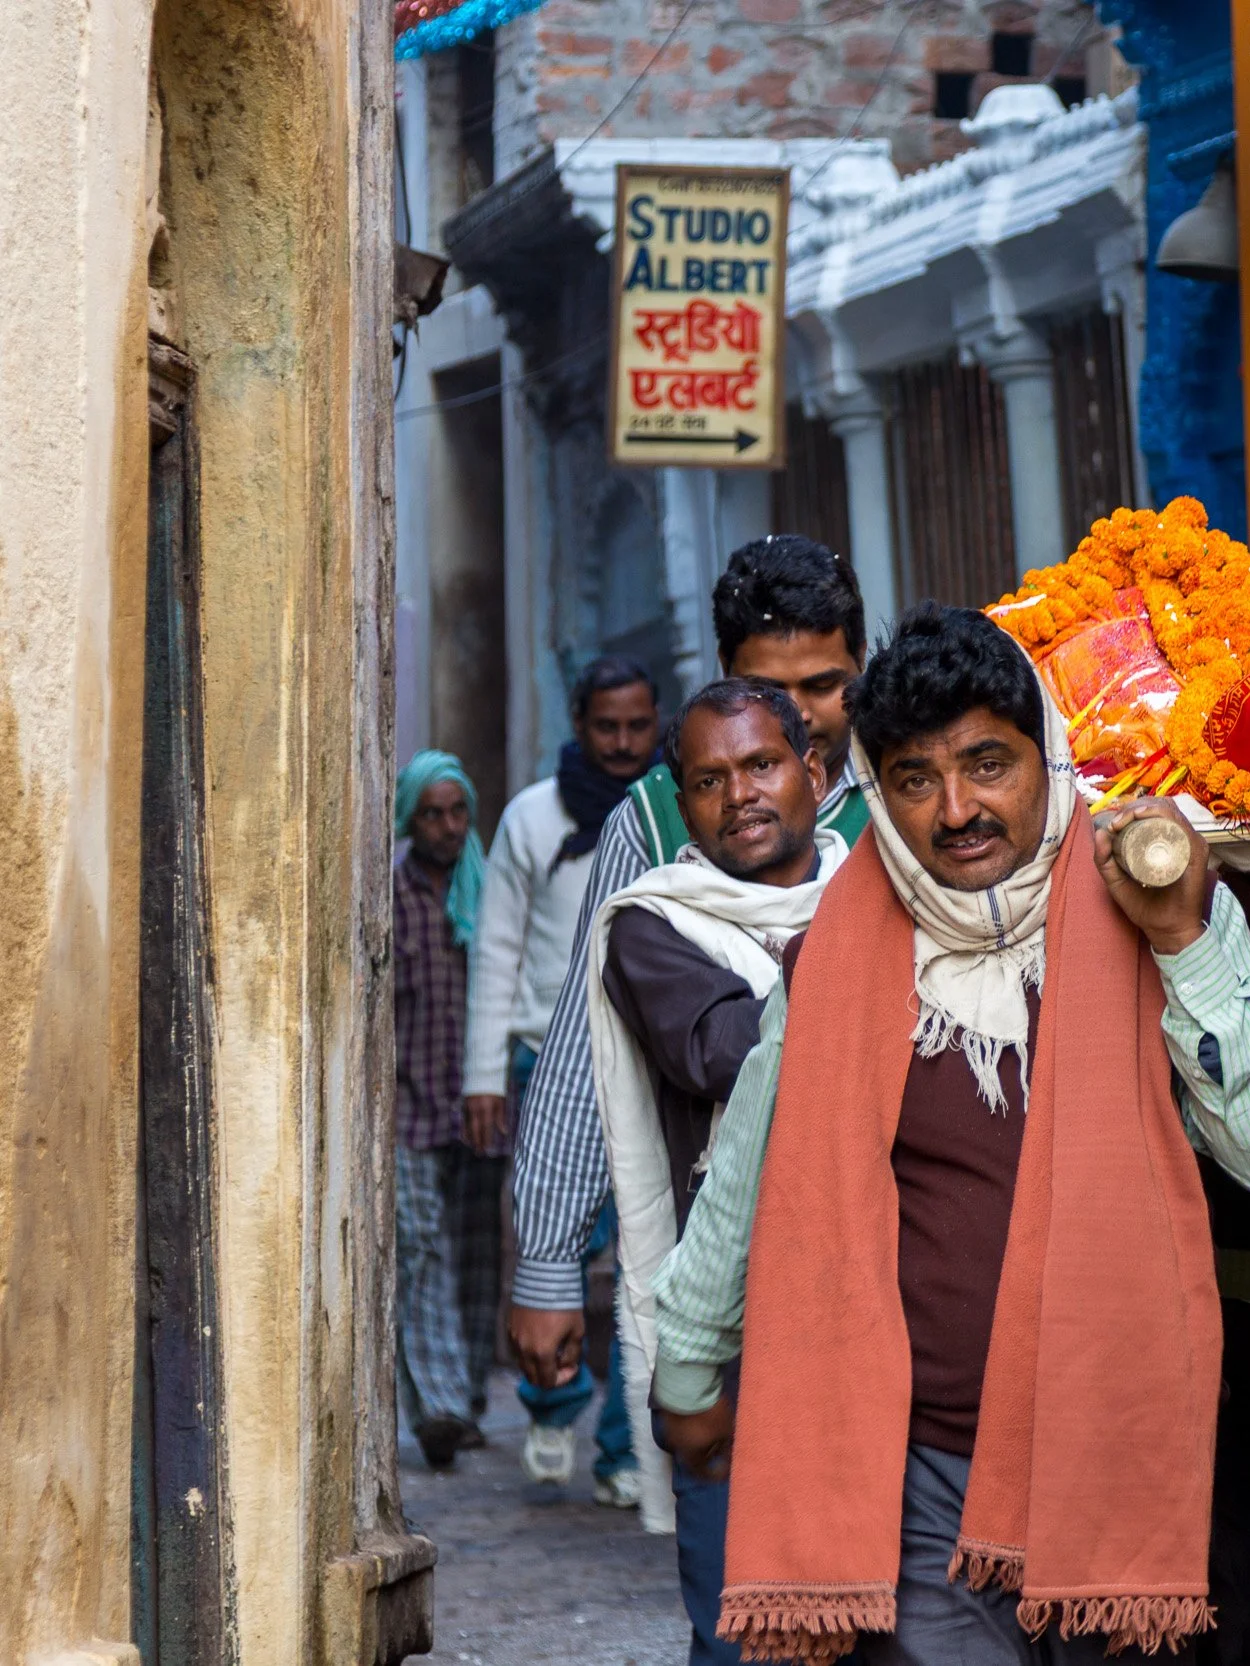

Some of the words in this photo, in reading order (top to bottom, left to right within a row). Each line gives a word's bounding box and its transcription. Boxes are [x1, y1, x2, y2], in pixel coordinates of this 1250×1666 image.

[627, 193, 771, 246] STUDIO
[624, 245, 770, 294] ALBERT
[633, 299, 762, 362] स्टूडियो
[628, 358, 759, 411] एलबर्ट
